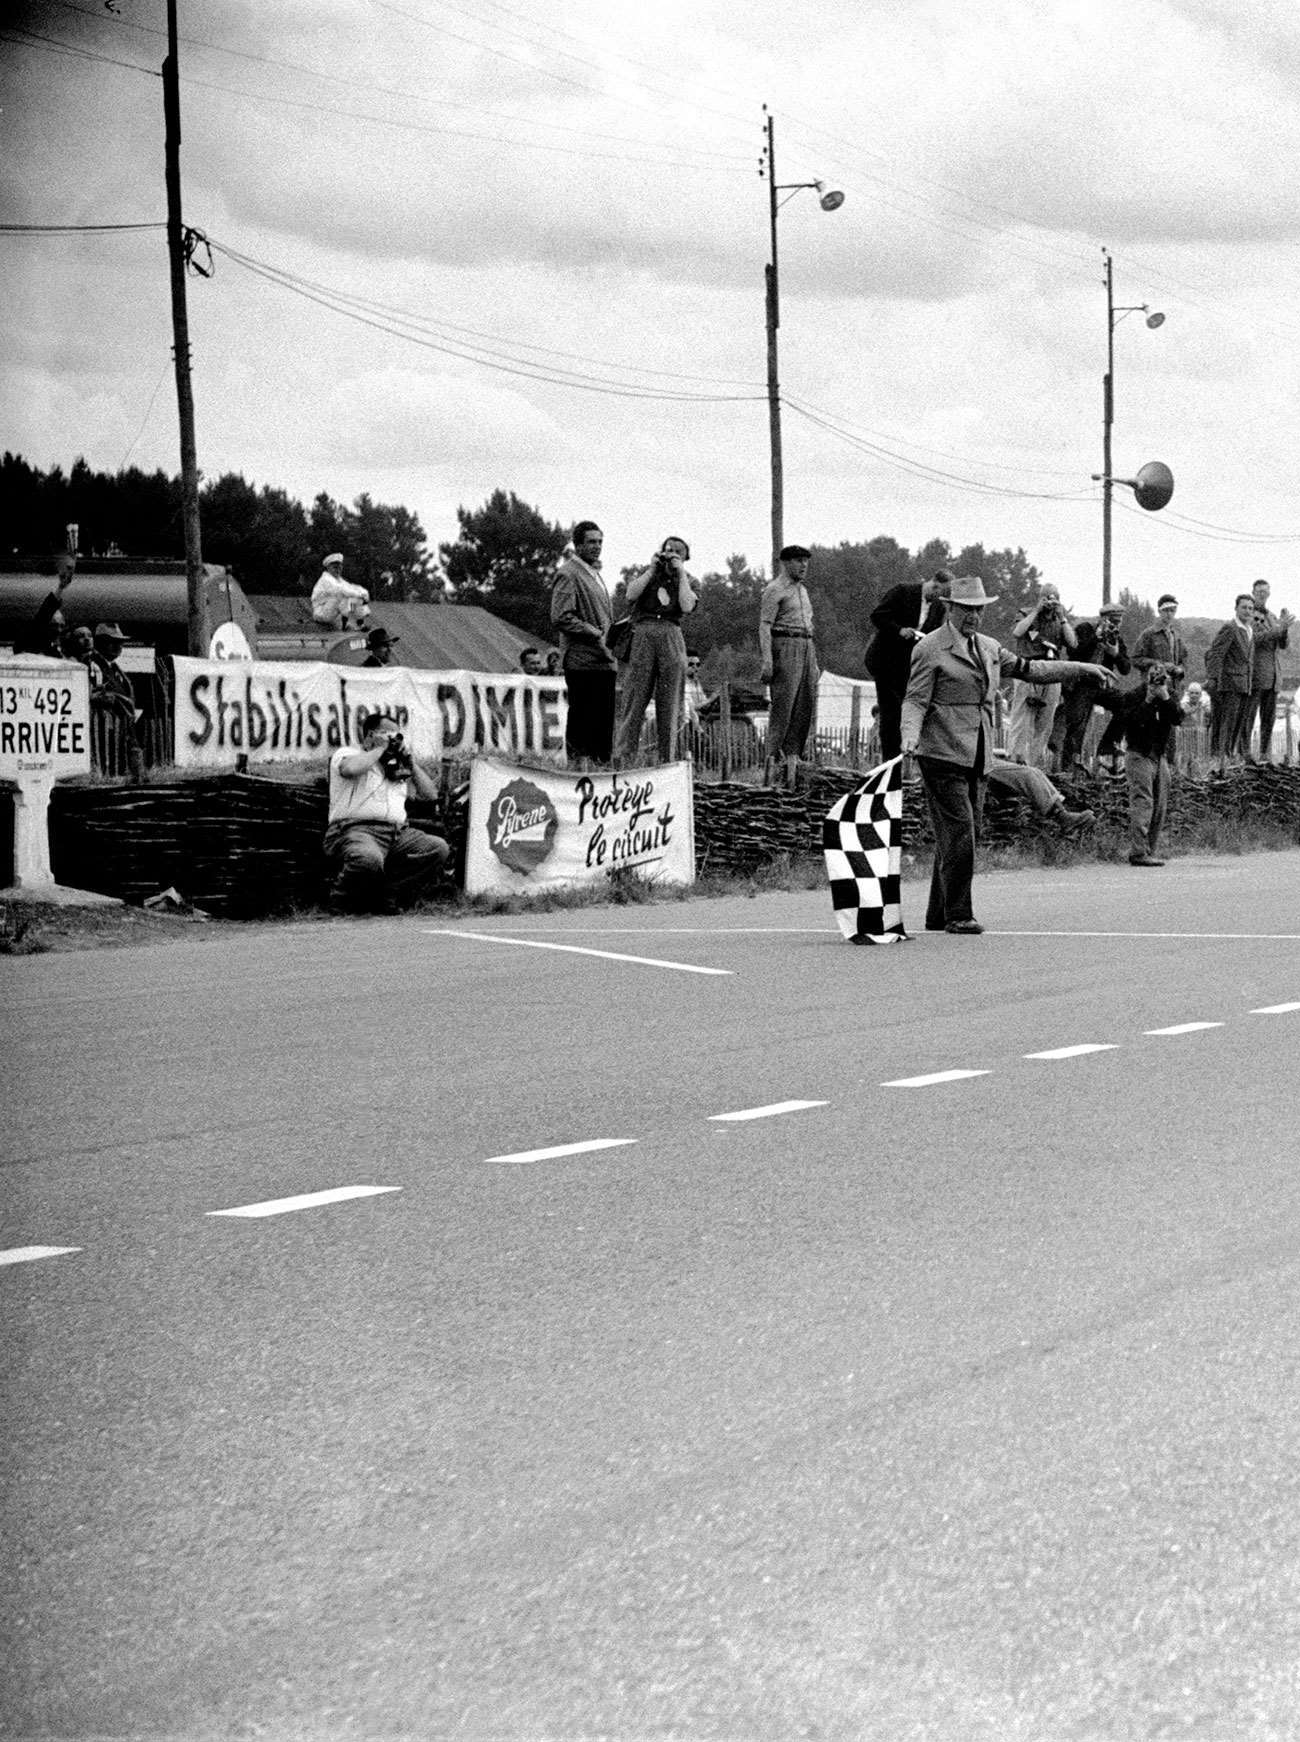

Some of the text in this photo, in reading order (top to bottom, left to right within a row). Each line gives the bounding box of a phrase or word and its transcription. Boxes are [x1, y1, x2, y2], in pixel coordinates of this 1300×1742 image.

[34, 688, 72, 715] 492
[188, 675, 568, 750] Stabilisater DIMIE
[1, 717, 85, 754] RRIVÉE
[494, 796, 548, 849] Pyrene
[575, 774, 655, 830] Protège
[586, 802, 675, 868] le circuit
